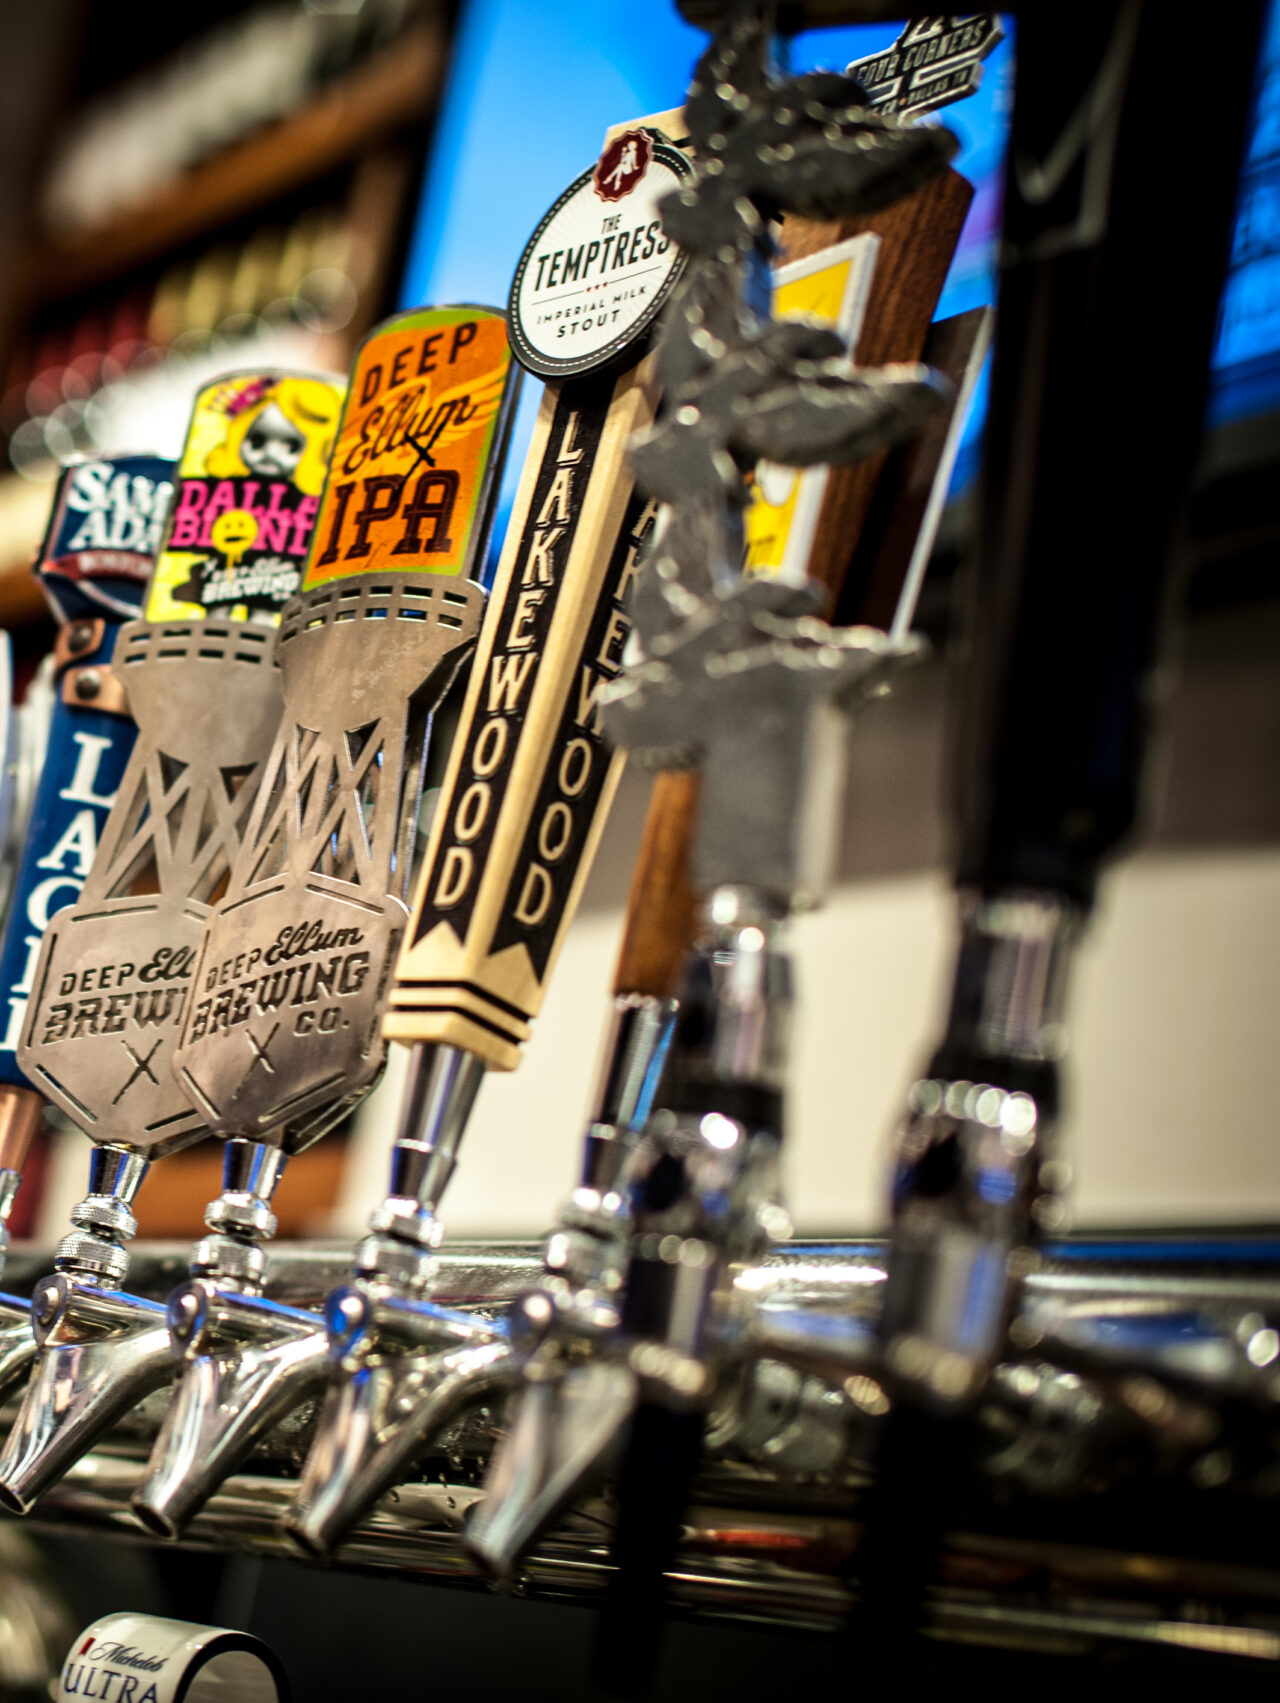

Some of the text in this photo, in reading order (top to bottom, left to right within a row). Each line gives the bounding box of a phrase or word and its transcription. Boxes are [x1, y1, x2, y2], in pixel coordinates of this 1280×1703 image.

[902, 18, 988, 72] CORNERS
[601, 213, 623, 235] THE
[536, 285, 647, 325] IMPERIAL MILK
[556, 309, 620, 338] STOUT
[359, 321, 478, 407] DEEP
[343, 383, 479, 476] Ellum
[180, 479, 321, 515] DALLA
[316, 469, 461, 566] IPA
[432, 410, 585, 911] LAKEWOOD
[58, 944, 198, 997] DEEP Ell
[206, 919, 365, 995] DEEP Ellum
[189, 950, 371, 1047] BREWING
[63, 1663, 159, 1703] ULTRA
[89, 1641, 171, 1673] Michelob
